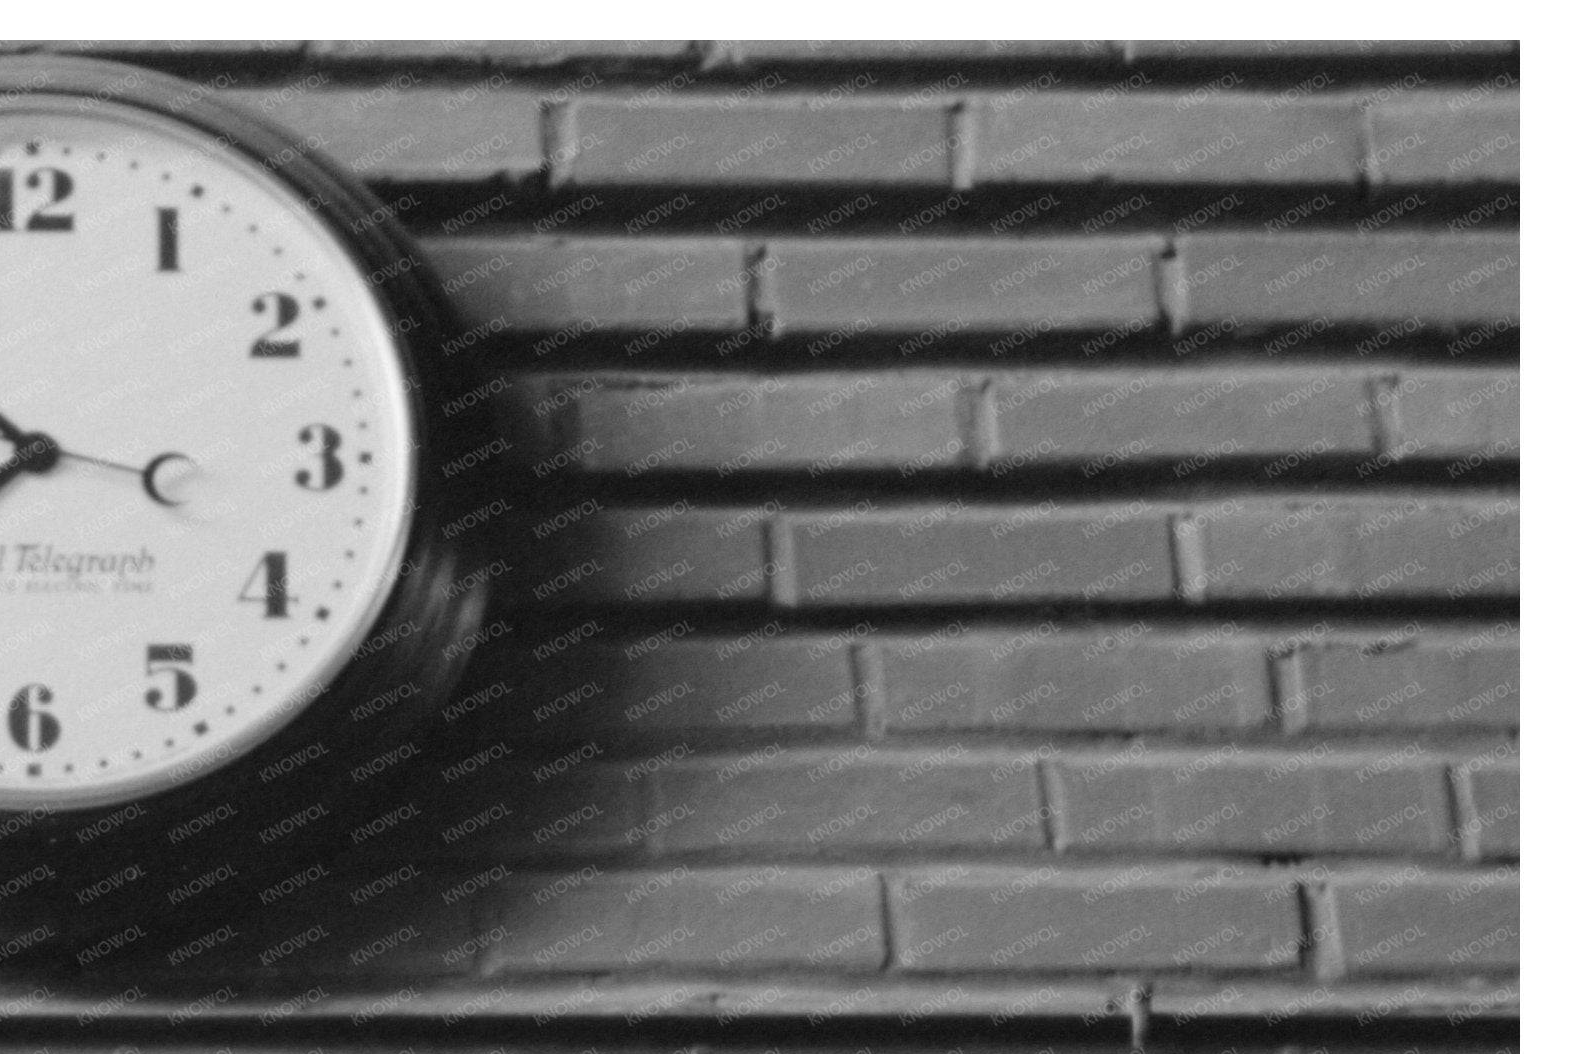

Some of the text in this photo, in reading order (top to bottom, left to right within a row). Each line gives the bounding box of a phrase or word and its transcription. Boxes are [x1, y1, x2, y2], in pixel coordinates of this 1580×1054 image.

[156, 207, 181, 272] 1
[249, 293, 302, 358] 2
[295, 424, 345, 491] 3
[15, 543, 156, 582] Telegraph
[237, 551, 300, 619] 4
[146, 644, 198, 712] 5
[7, 684, 61, 753] 6
